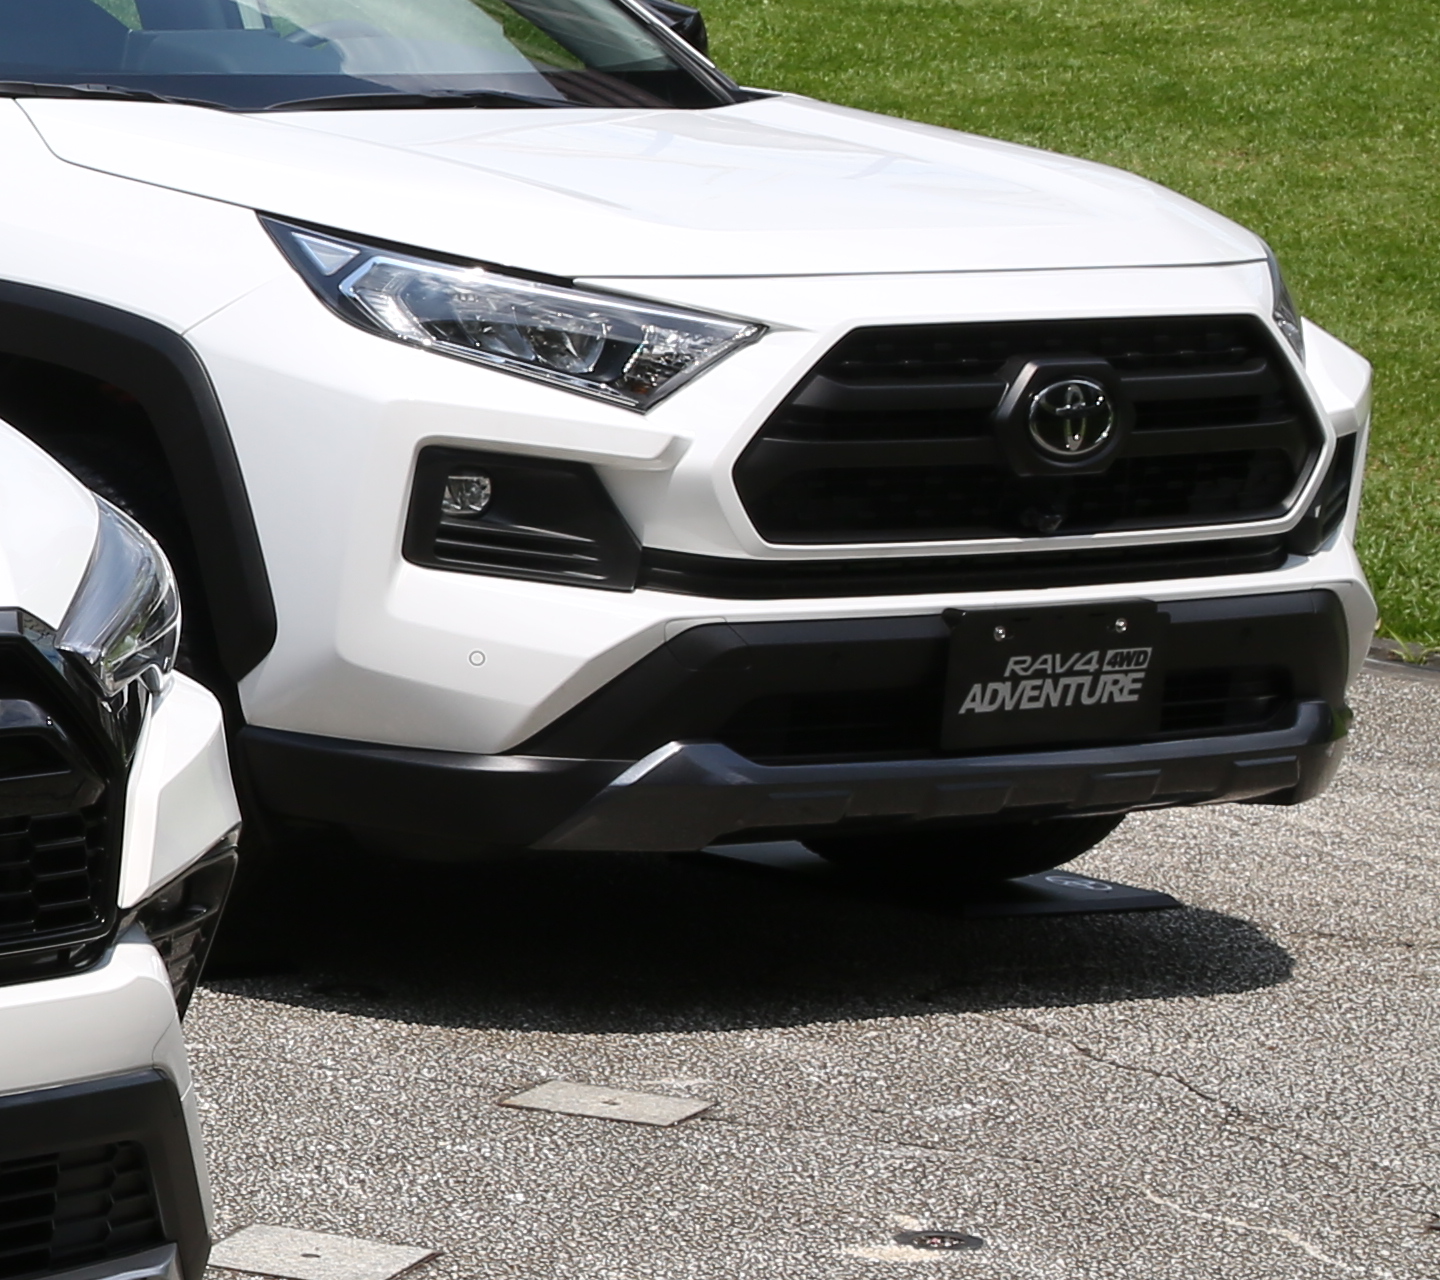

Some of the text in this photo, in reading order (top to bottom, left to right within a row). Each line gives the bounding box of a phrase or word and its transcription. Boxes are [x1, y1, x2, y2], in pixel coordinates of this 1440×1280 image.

[1003, 648, 1151, 677] RAV4 4WD
[958, 672, 1146, 714] ADVENTURE
